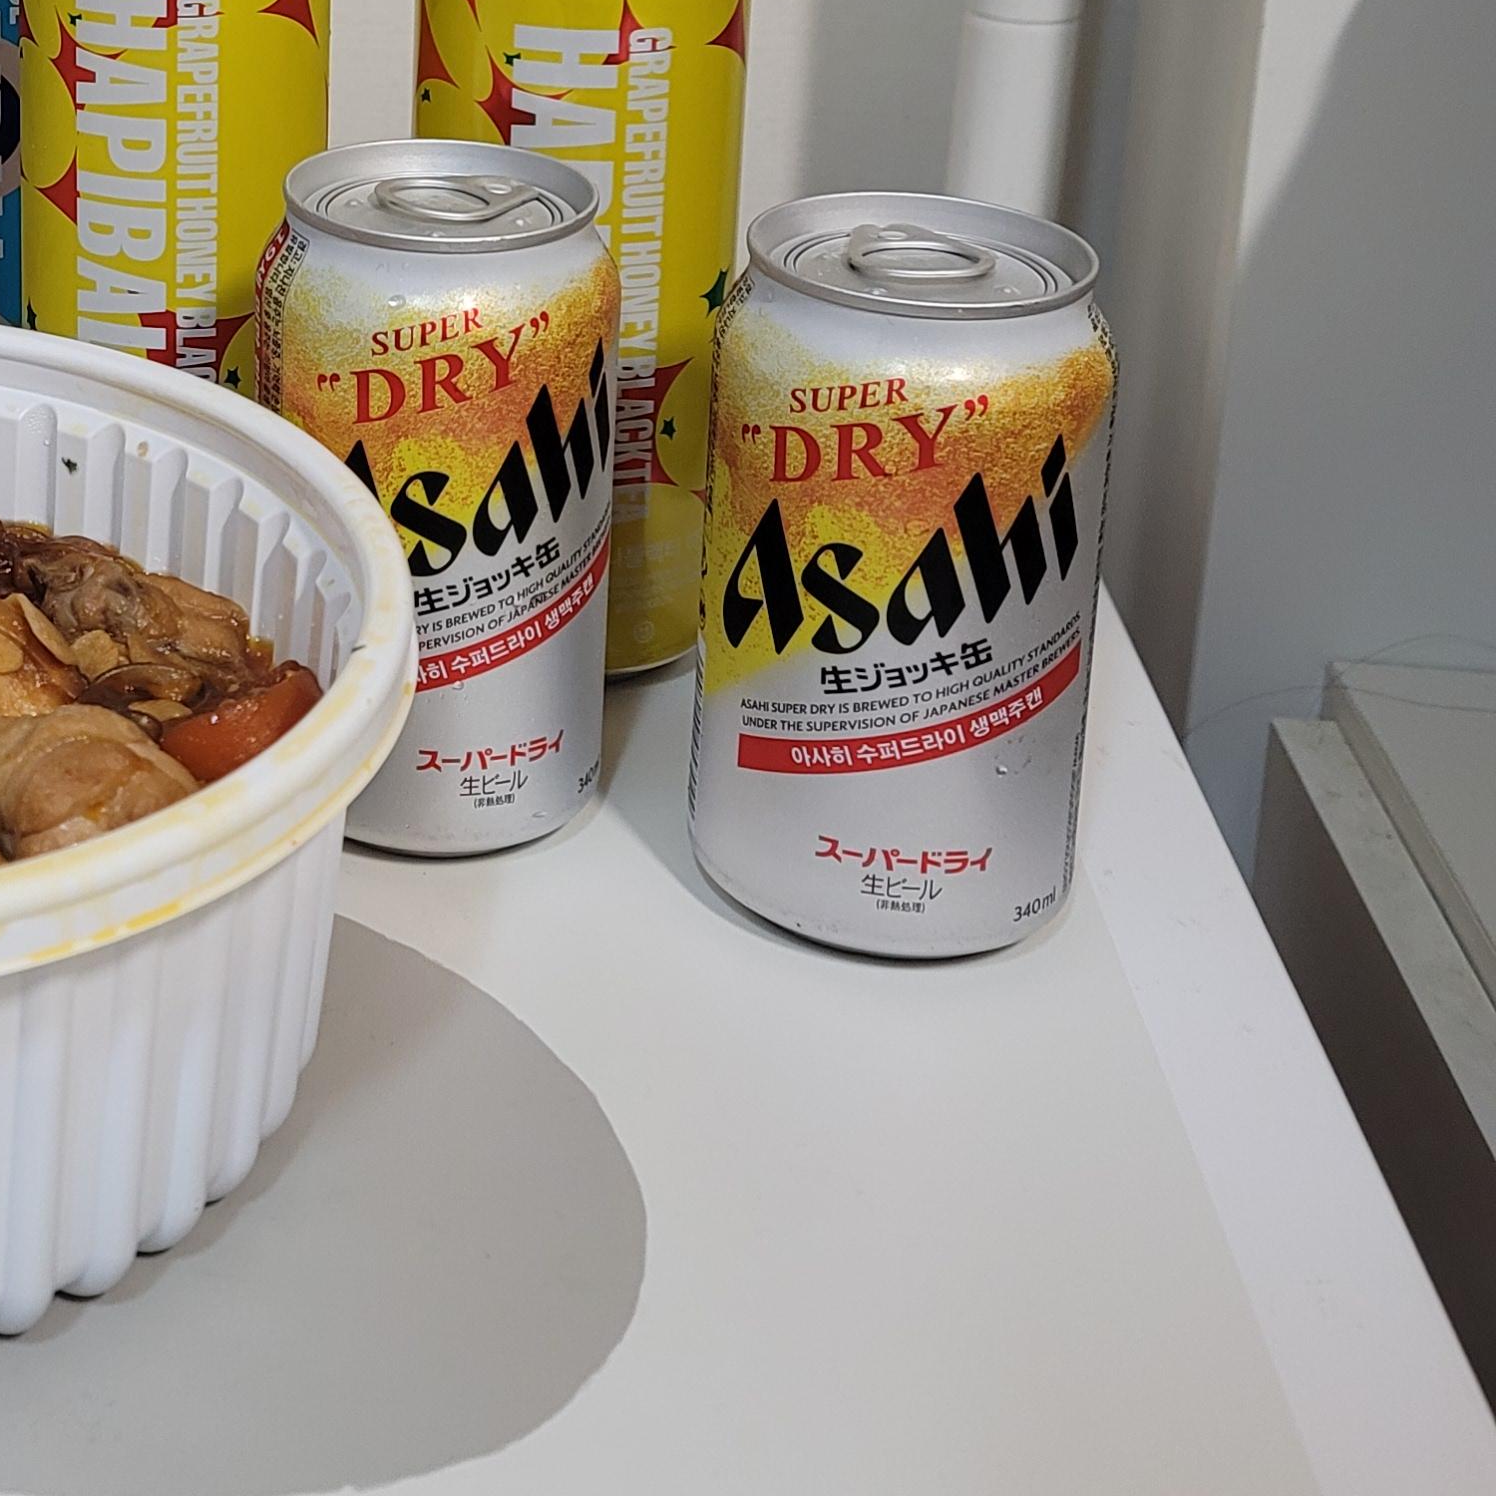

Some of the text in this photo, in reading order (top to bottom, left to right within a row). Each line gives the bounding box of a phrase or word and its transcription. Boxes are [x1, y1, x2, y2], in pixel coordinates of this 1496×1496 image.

[620, 27, 673, 237] GRAPEFRUIT
[176, 197, 218, 302] HONEY
[371, 307, 483, 356] SUPER
[618, 240, 662, 352] HONEY
[789, 377, 909, 413] SUPER
[345, 336, 611, 577] sahi
[414, 537, 561, 617] 生ジョッキ缶
[723, 434, 1078, 654] Asahi
[416, 620, 430, 635] RY
[432, 619, 444, 631] IS
[445, 603, 496, 629] BREWED
[498, 595, 515, 610] TO
[516, 578, 544, 601] HIGH
[545, 547, 583, 584] QUALITY
[417, 658, 449, 685] 사히
[450, 620, 544, 675] 수퍼드라이
[544, 571, 596, 630] 생맥주캔
[418, 623, 485, 652] PERVISION
[487, 616, 506, 630] OF
[507, 586, 560, 623] JAPANESE
[561, 551, 592, 589] MASTER
[740, 610, 1082, 715] ASAHI SUPER DRY IS BREWED TO HIGH QUALITY STANDARDS
[742, 625, 1082, 733] UNDER THE SUPERVISION OF JAPANESE MASTER BREWERS
[820, 637, 993, 694] 生ジョッキ缶
[416, 729, 565, 773] スーパードライ
[791, 685, 1044, 769] 아사히 수퍼드라이 생맥주캔
[460, 770, 529, 797] 生ビール
[815, 834, 993, 875] スーパードライ
[860, 873, 943, 901] 生ビール
